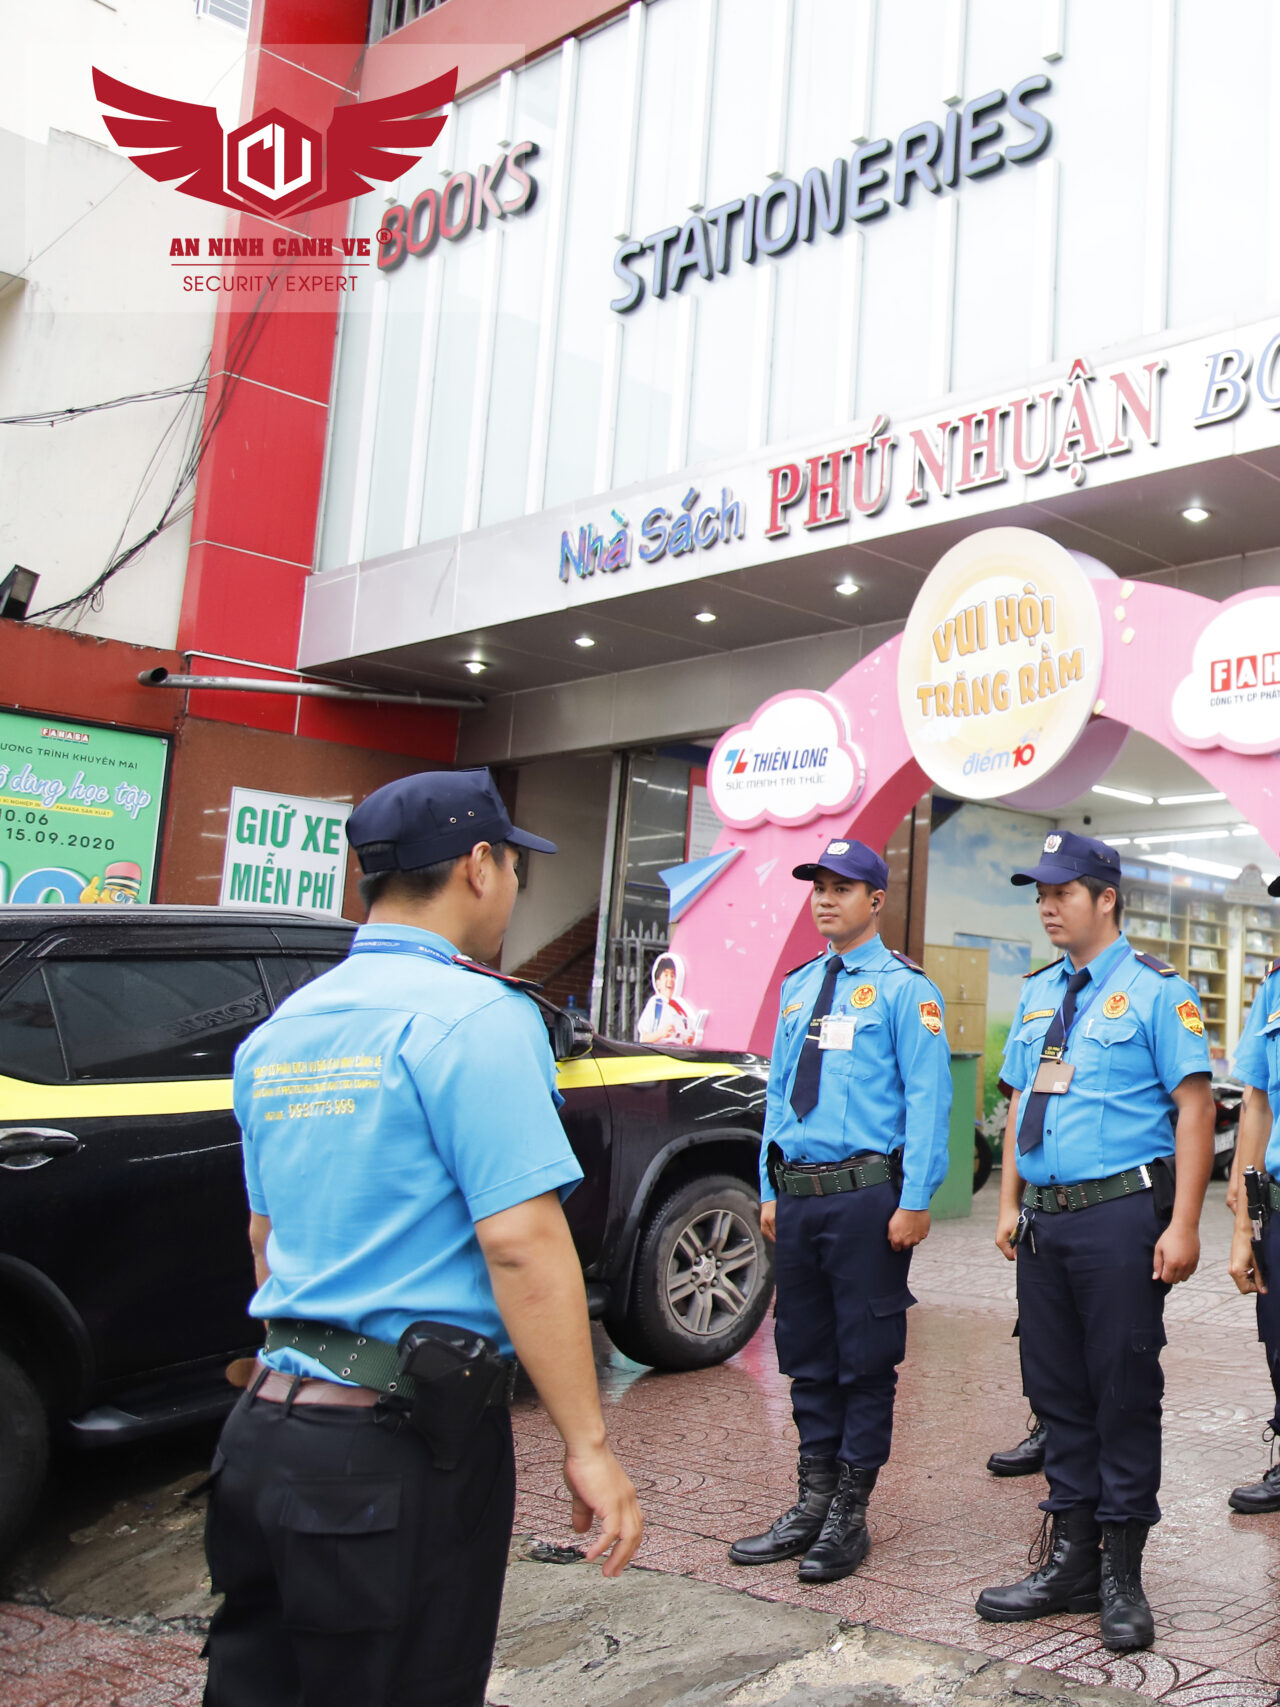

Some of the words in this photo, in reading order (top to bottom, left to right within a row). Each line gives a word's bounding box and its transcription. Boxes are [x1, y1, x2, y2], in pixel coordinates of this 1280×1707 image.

[376, 140, 539, 273] BOOKS
[609, 73, 1053, 315] STATIONERIES
[558, 510, 632, 581] Nhà
[637, 487, 746, 563] Sách
[763, 413, 895, 538] PHÚ
[906, 358, 1167, 504] NHUẬN
[932, 601, 987, 663] VUI
[995, 582, 1055, 646] HỘI
[916, 670, 1010, 717] TRĂNG
[1018, 642, 1085, 704] RẰM
[1210, 694, 1232, 707] CÔNG
[1235, 694, 1244, 704] TY
[1247, 693, 1258, 703] CP
[1260, 688, 1280, 700] PHÁT
[41, 728, 90, 742] FAHASA
[753, 746, 791, 773] THIÊN
[792, 747, 828, 769] LONG
[1012, 743, 1035, 768] 10
[10, 763, 66, 808] dùng
[68, 770, 109, 805] học
[115, 781, 151, 820] tập
[7, 827, 114, 850] 15.09.2020
[236, 804, 297, 848] GIỮ
[301, 815, 342, 855] XE
[230, 852, 291, 905] MIỄN
[297, 866, 336, 910] PHÍ
